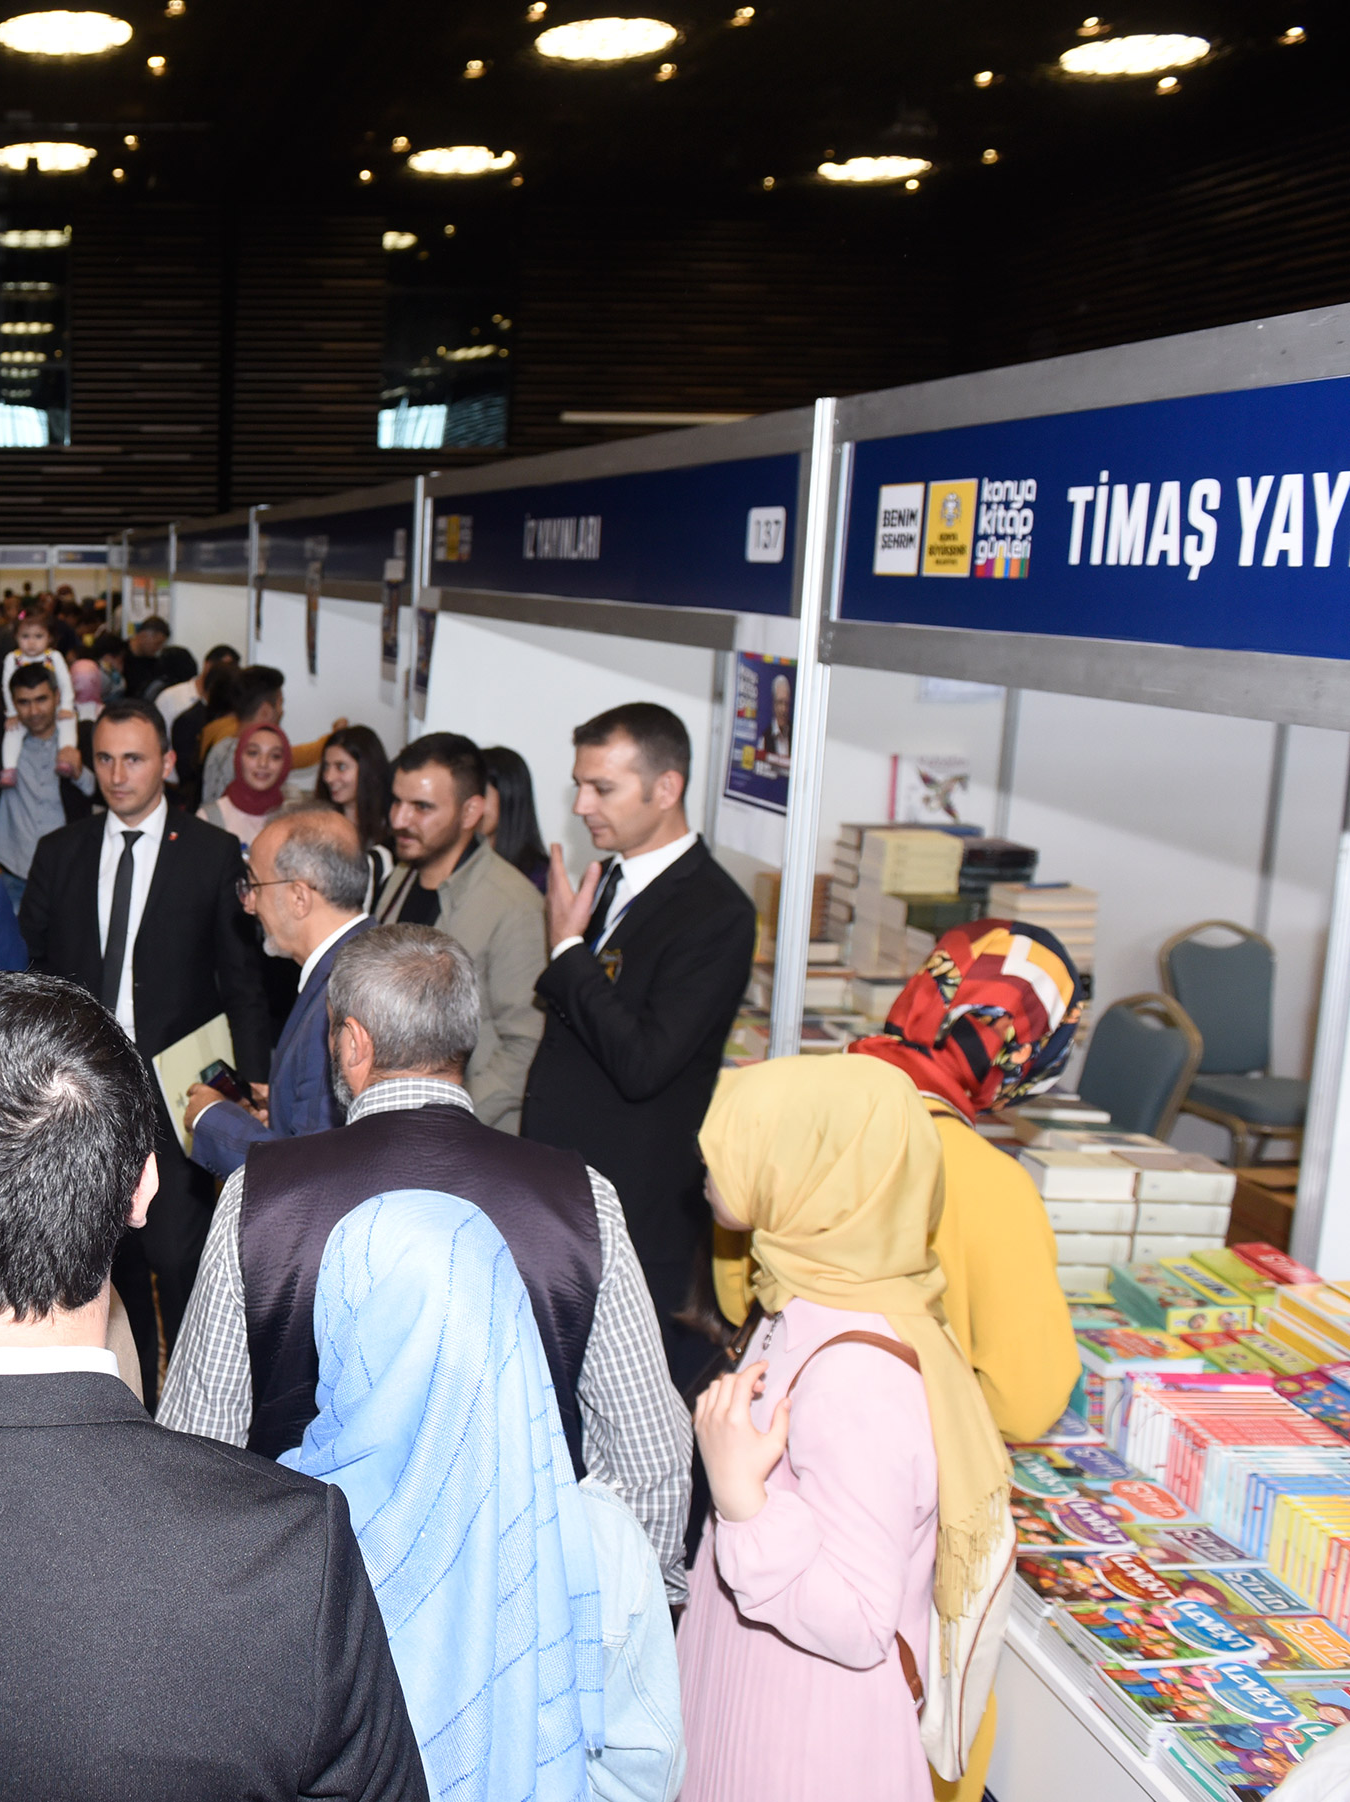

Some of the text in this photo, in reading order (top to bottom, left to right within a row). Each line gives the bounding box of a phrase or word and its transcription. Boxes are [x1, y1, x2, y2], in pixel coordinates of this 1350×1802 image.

[981, 477, 1037, 509] konya
[755, 519, 781, 549] 137
[978, 503, 1034, 537] kitap
[1067, 469, 1350, 581] TİMAŞ YAY
[975, 535, 1032, 565] günleri
[1068, 1501, 1127, 1543] LEVENT
[1110, 1554, 1176, 1599] LEVENT
[1176, 1603, 1253, 1649] LEVENT
[1219, 1665, 1296, 1717] LEVENT
